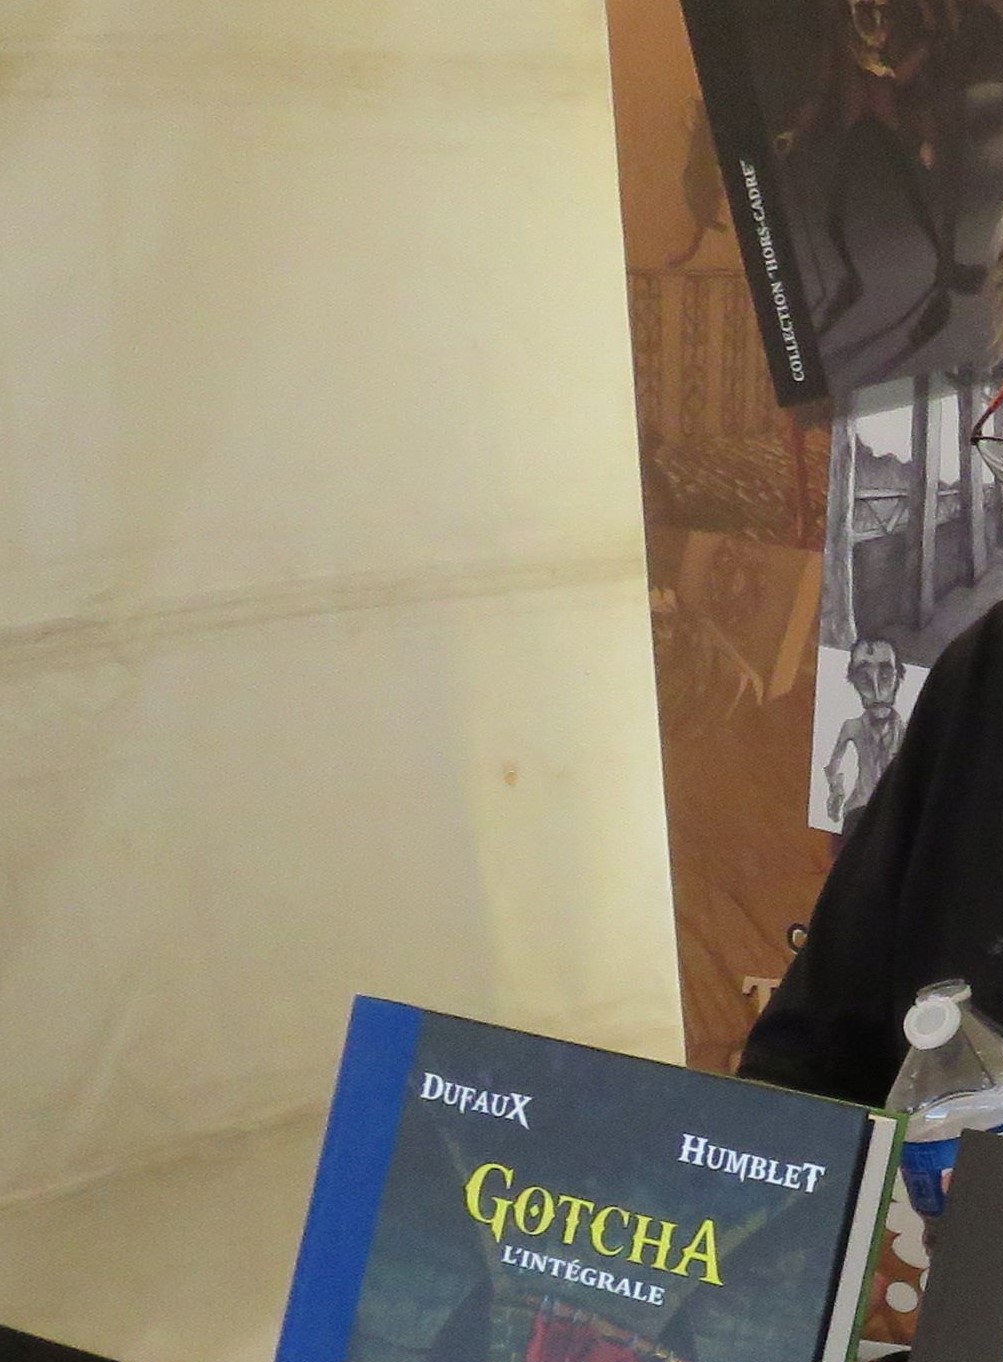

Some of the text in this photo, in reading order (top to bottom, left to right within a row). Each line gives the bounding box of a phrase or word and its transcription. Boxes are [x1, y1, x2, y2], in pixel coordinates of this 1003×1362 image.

[771, 282, 804, 382] COLLECTION
[421, 1072, 532, 1129] DUFAUX
[678, 1133, 826, 1193] HUMBLET
[464, 1162, 725, 1287] GOTCHA
[502, 1245, 666, 1306] L'INTÉGRALE
